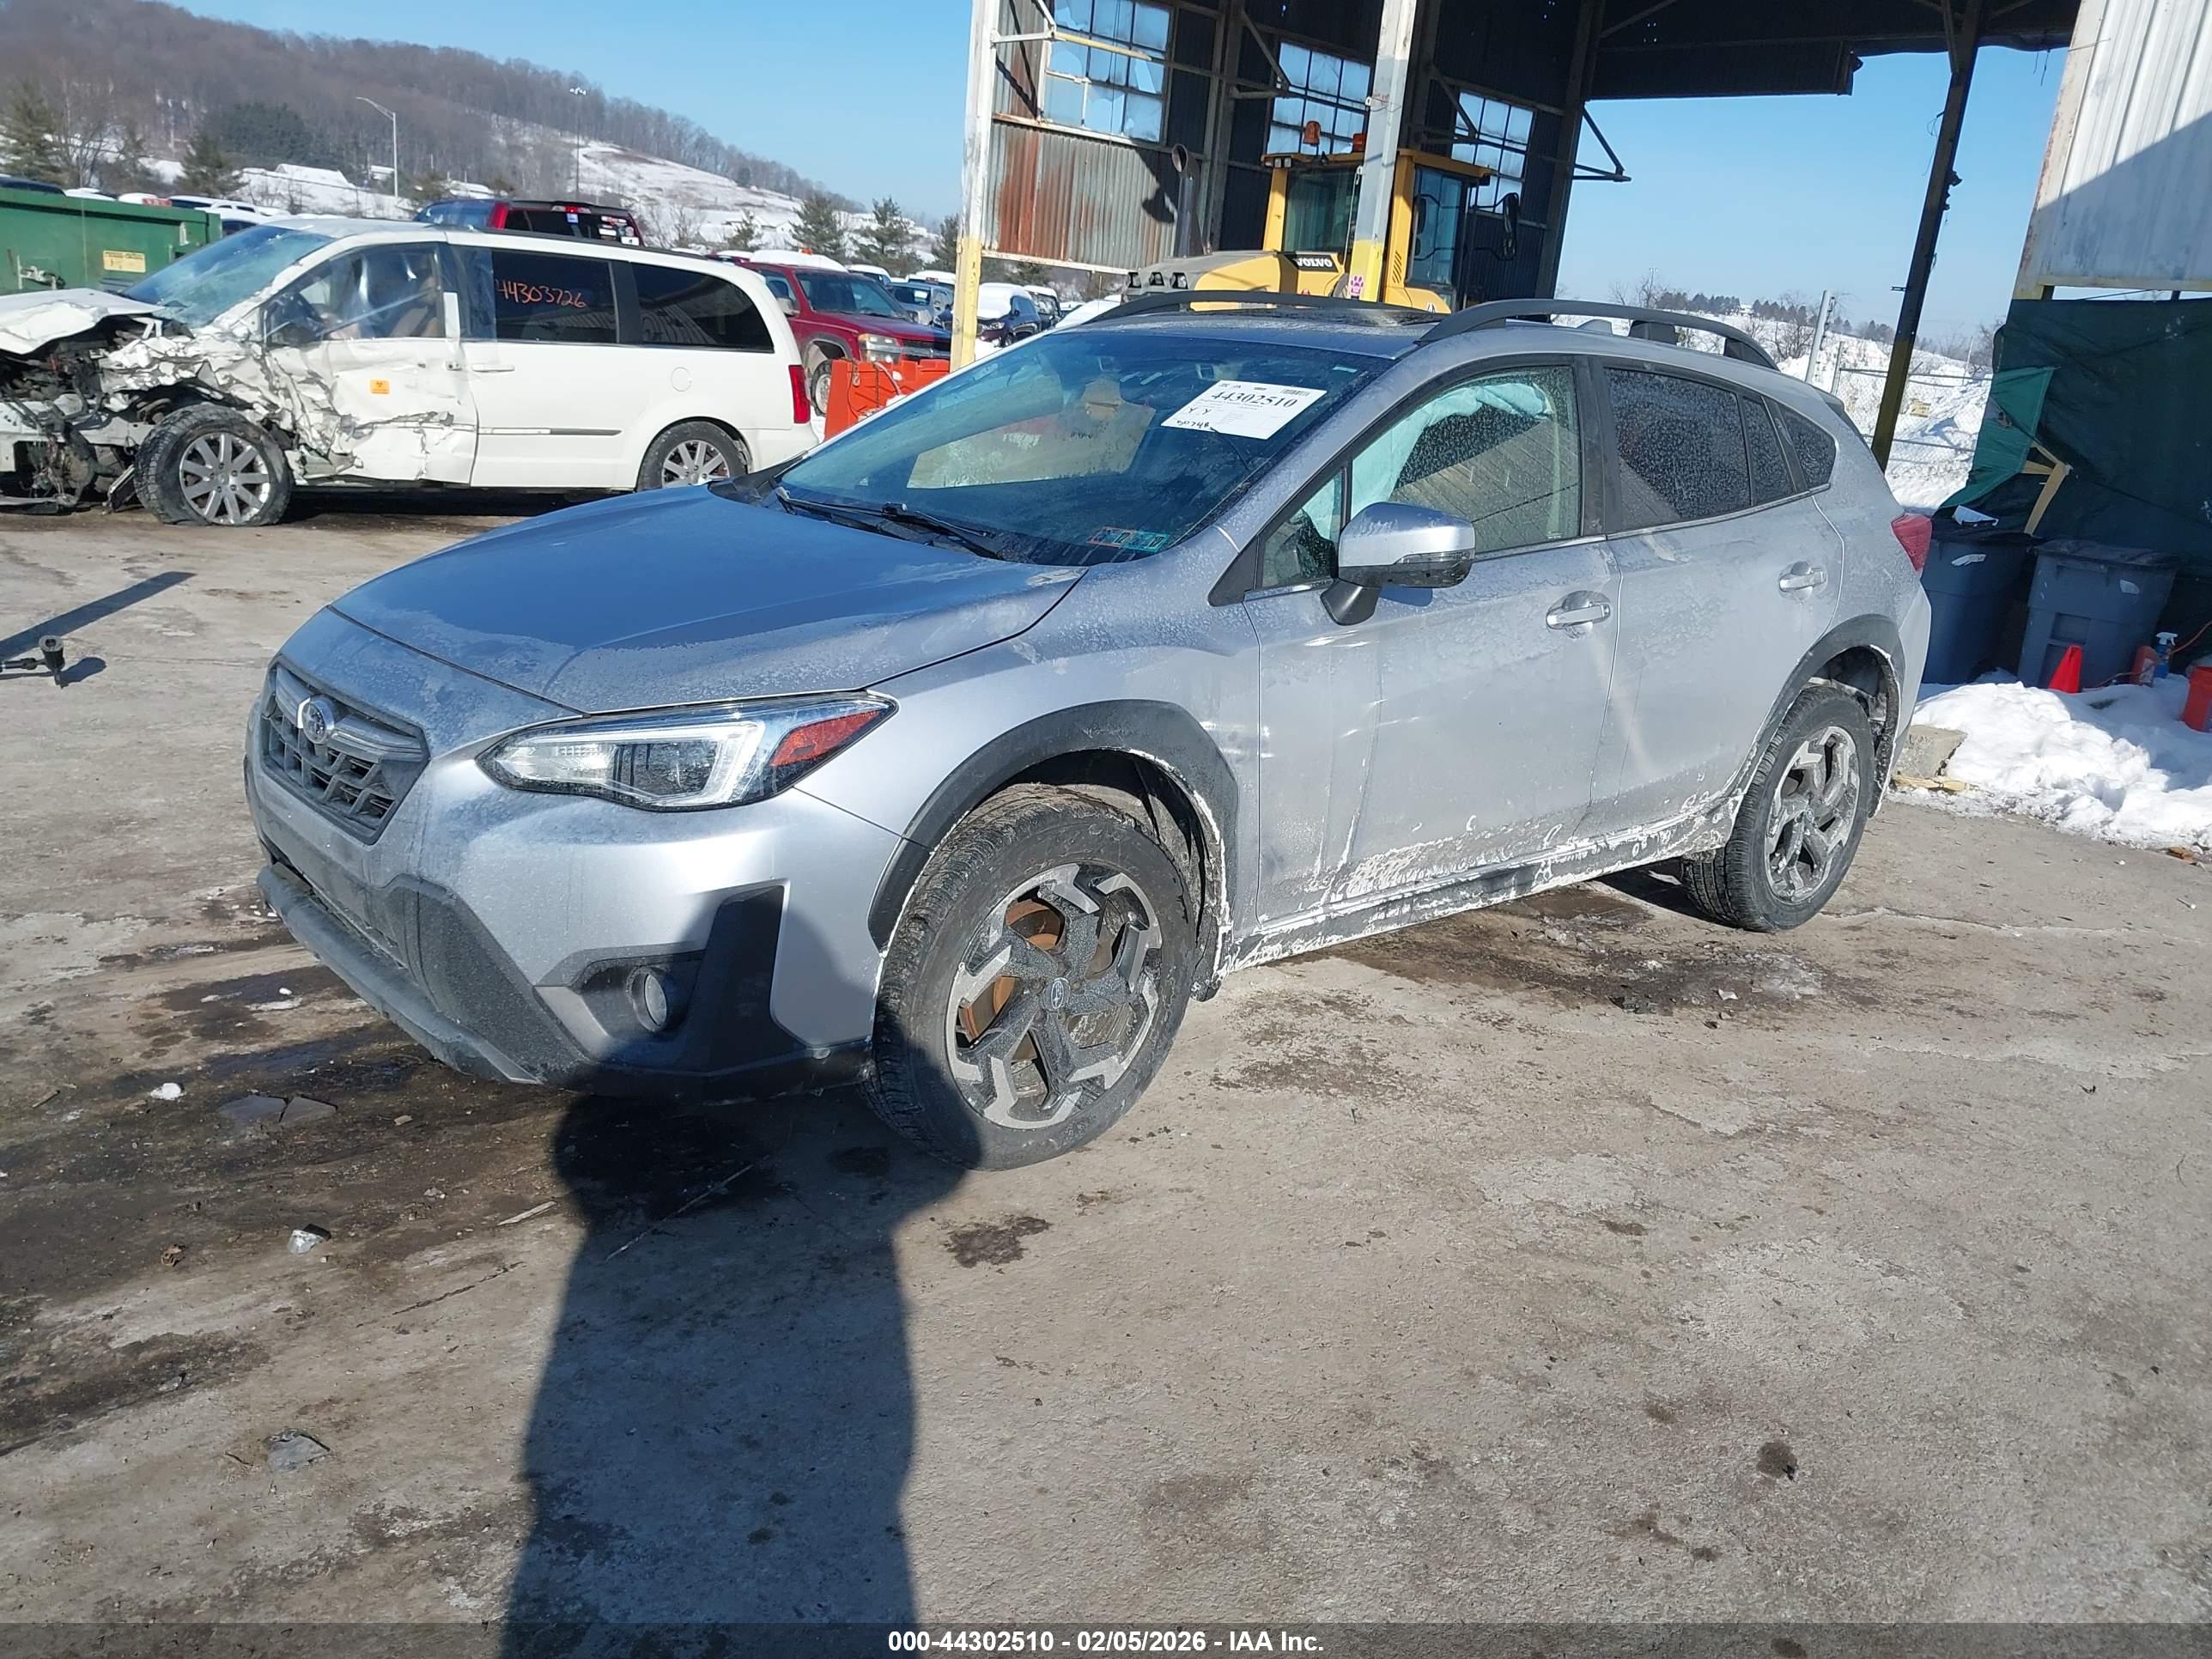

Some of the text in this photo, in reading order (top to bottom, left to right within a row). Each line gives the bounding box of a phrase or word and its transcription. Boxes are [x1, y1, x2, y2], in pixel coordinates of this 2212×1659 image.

[1293, 258, 1334, 268] VOLVO
[495, 279, 586, 308] 44303726
[1211, 391, 1298, 408] 44302510
